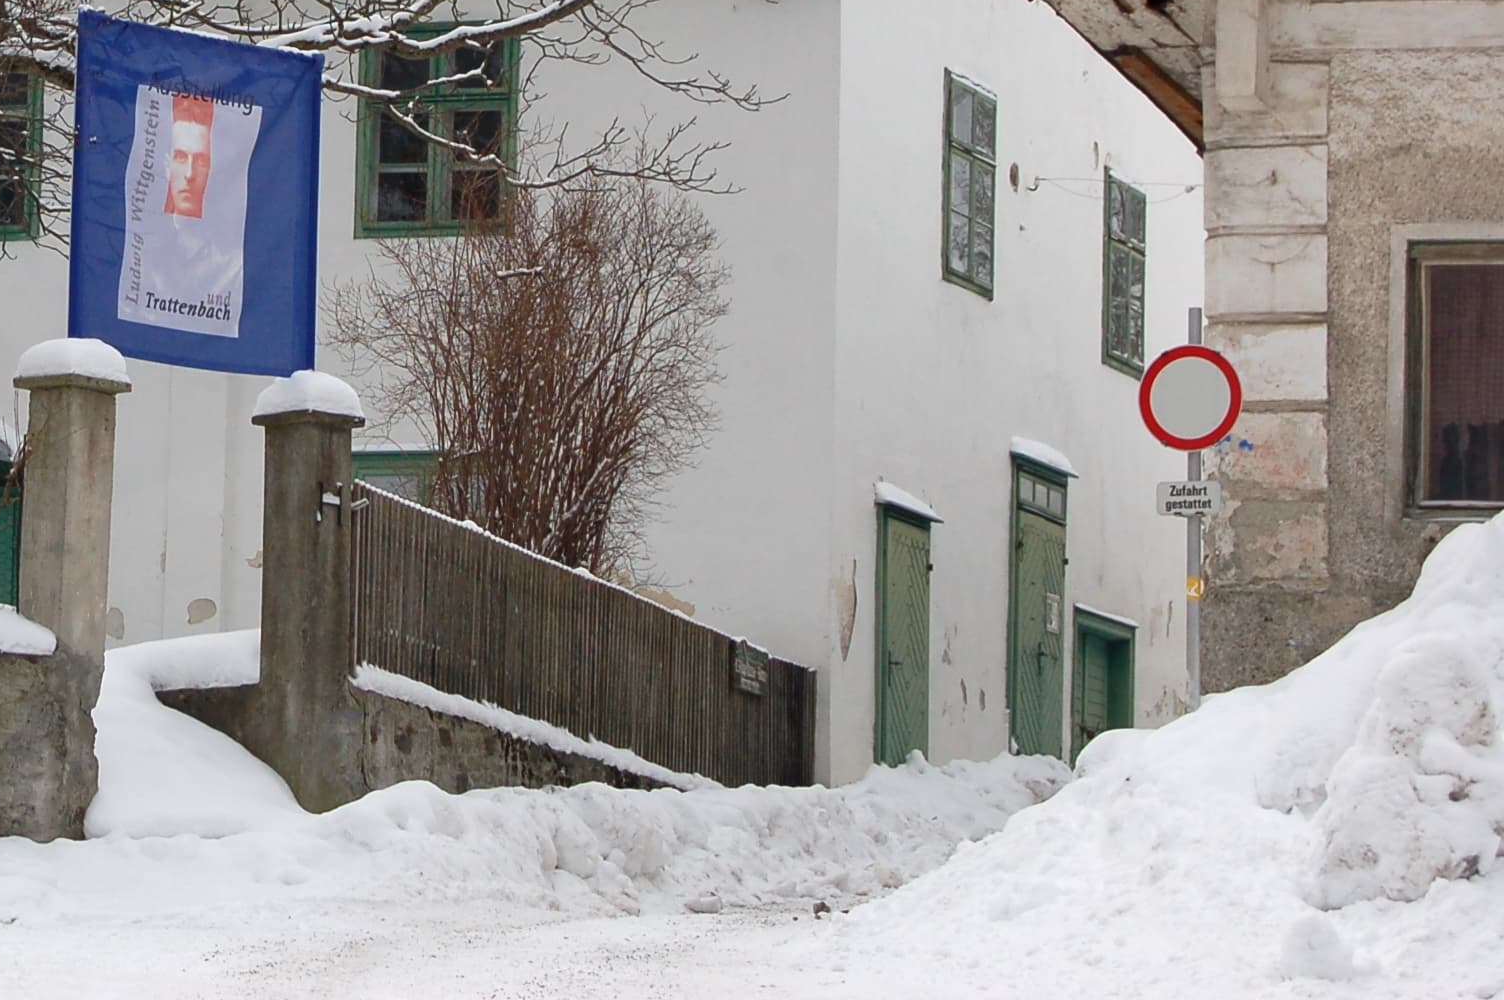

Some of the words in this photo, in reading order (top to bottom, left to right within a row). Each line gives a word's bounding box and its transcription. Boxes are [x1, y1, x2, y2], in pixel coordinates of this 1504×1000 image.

[148, 72, 255, 116] Ausstellung
[131, 100, 160, 222] Wittgenstein
[125, 233, 144, 305] Ludwig
[145, 291, 231, 321] Trattenbach
[207, 290, 232, 307] und
[1165, 498, 1212, 512] gestattet
[1169, 484, 1208, 497] Zufahrt
